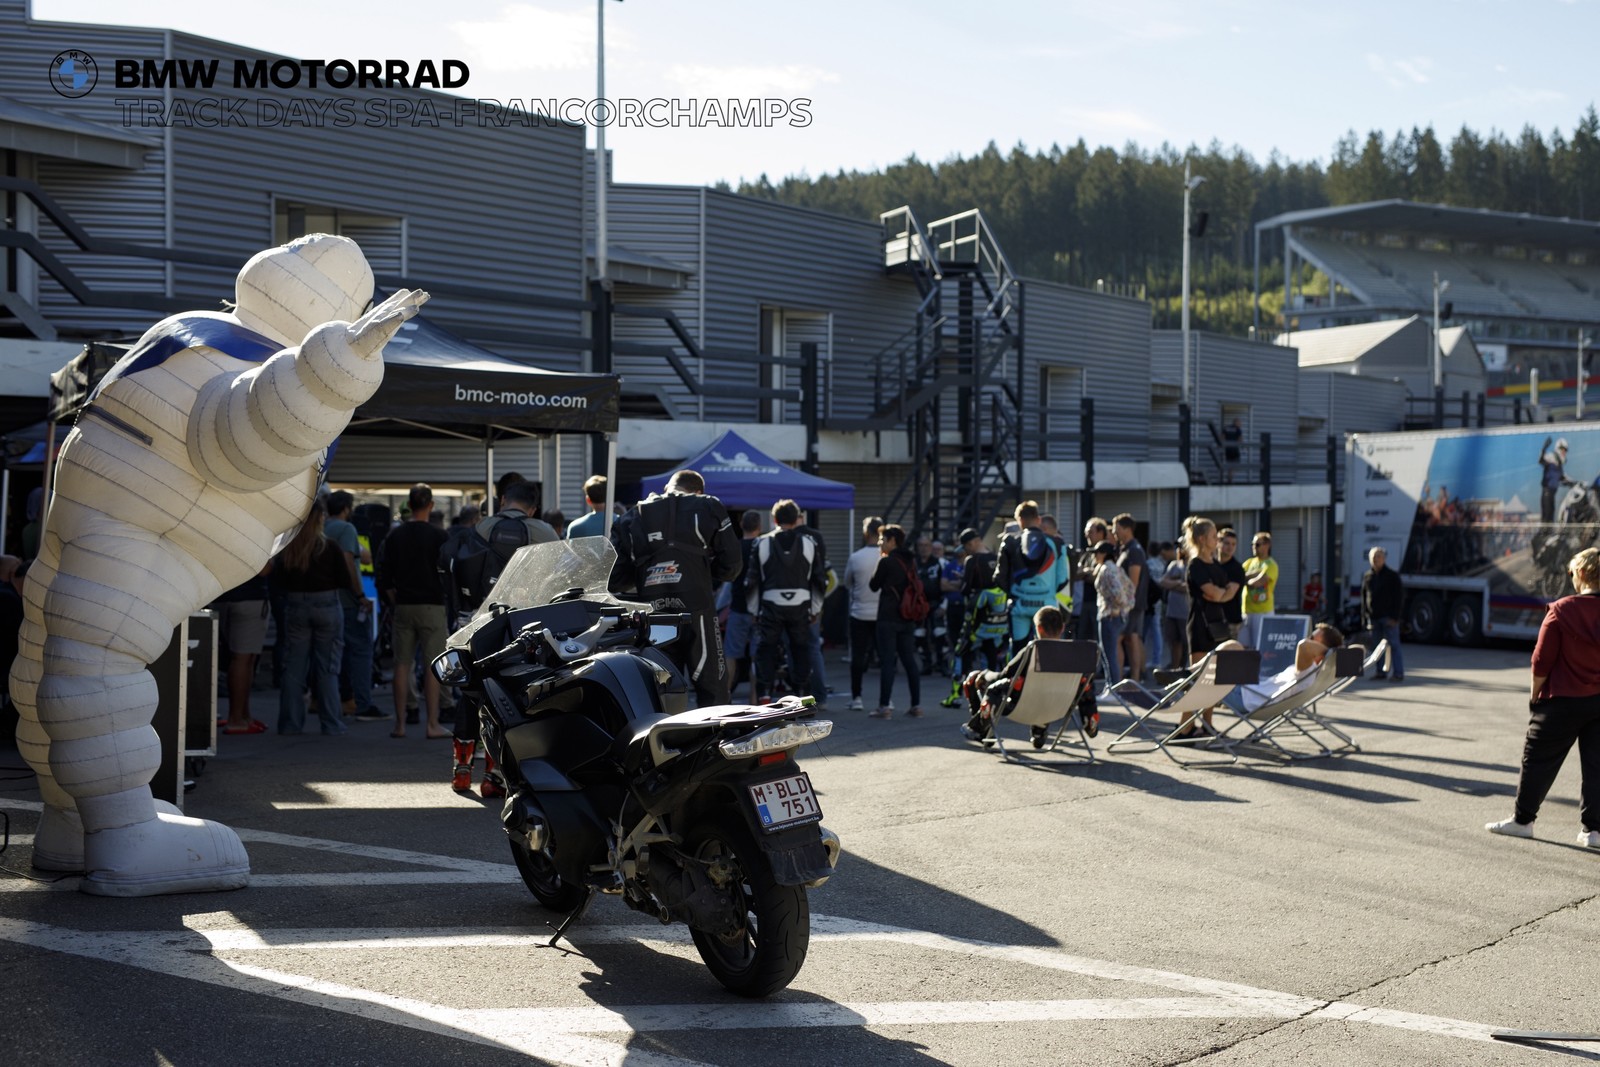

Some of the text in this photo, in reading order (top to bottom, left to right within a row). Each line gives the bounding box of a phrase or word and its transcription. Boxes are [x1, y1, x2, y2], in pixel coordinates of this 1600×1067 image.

[454, 384, 588, 409] bmc-moto.com
[1267, 632, 1298, 642] STAND
[781, 796, 814, 817] 751
[763, 815, 770, 823] B
